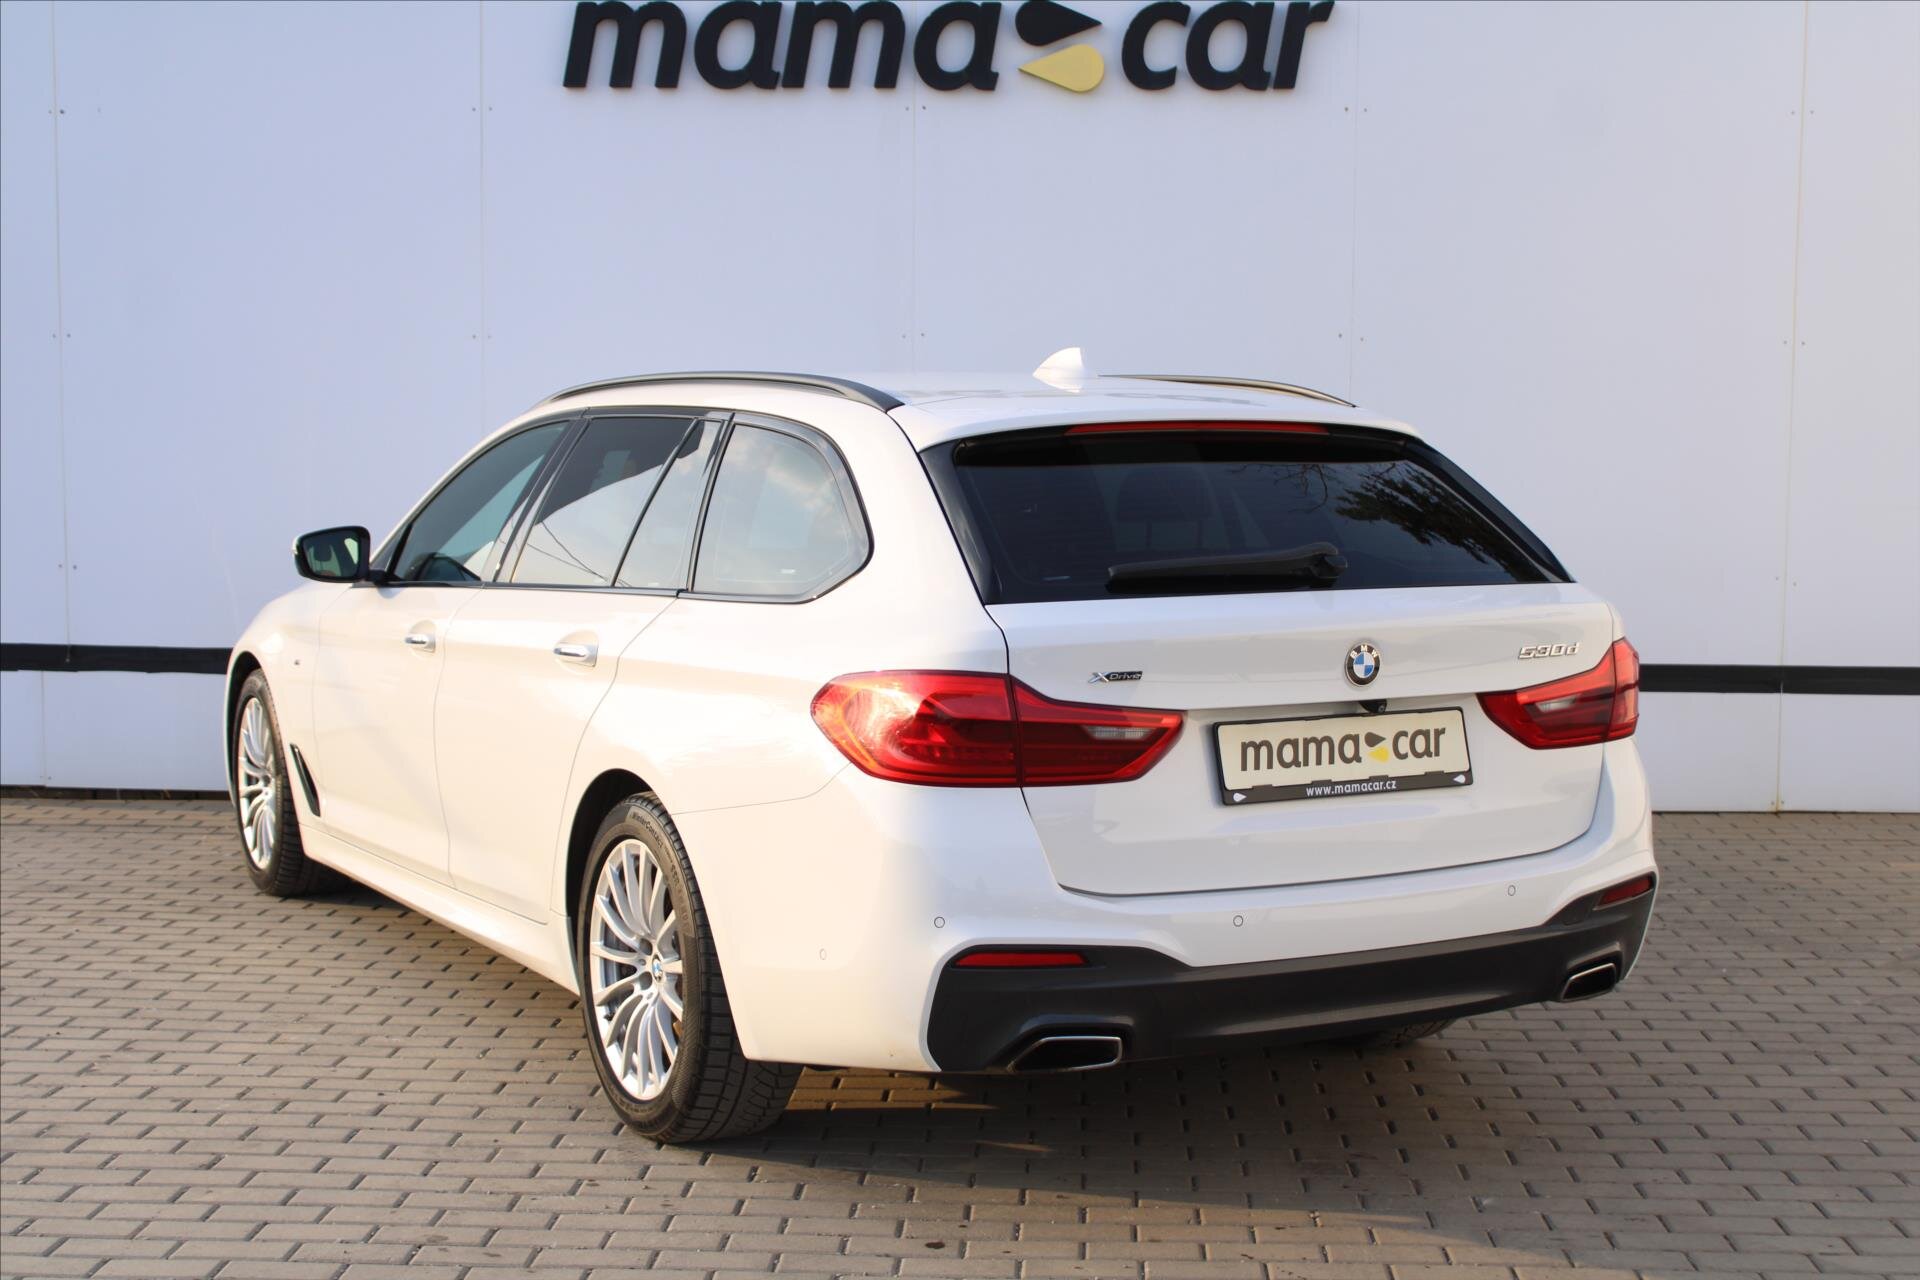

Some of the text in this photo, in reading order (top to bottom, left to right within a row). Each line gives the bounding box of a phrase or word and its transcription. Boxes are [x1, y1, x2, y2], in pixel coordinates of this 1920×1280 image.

[563, 0, 1335, 90] mama car
[1518, 642, 1580, 659] 530d
[1240, 727, 1446, 771] mama car
[1306, 780, 1397, 796] www.mamacar.cz
